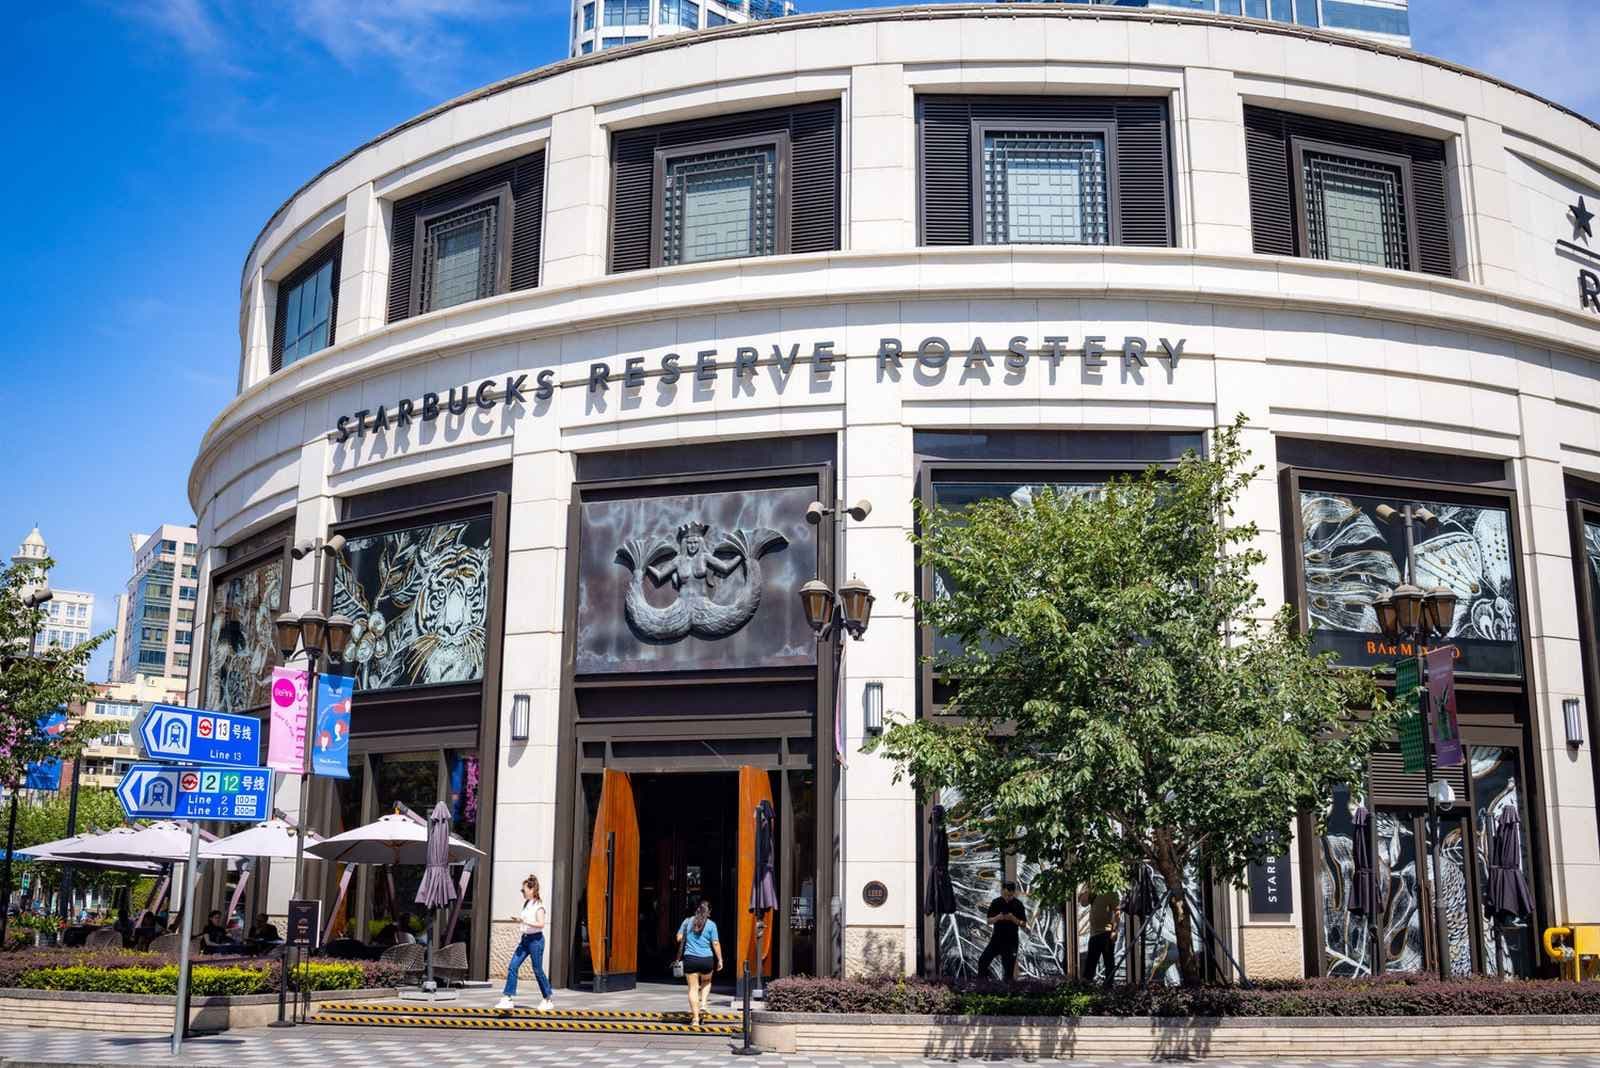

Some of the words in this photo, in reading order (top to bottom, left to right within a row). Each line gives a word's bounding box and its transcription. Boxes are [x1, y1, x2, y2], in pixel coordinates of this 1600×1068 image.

[336, 369, 555, 443] STARBUCKS
[590, 341, 835, 393] RESERVE
[879, 335, 1187, 369] ROASTERY
[210, 749, 229, 760] Line
[233, 752, 242, 761] 13
[206, 775, 217, 791] 2
[224, 775, 239, 791] 12
[188, 794, 211, 804] Line
[221, 795, 228, 805] 2
[187, 805, 210, 815] Line
[217, 806, 229, 815] 12
[1266, 828, 1278, 903] STARB
